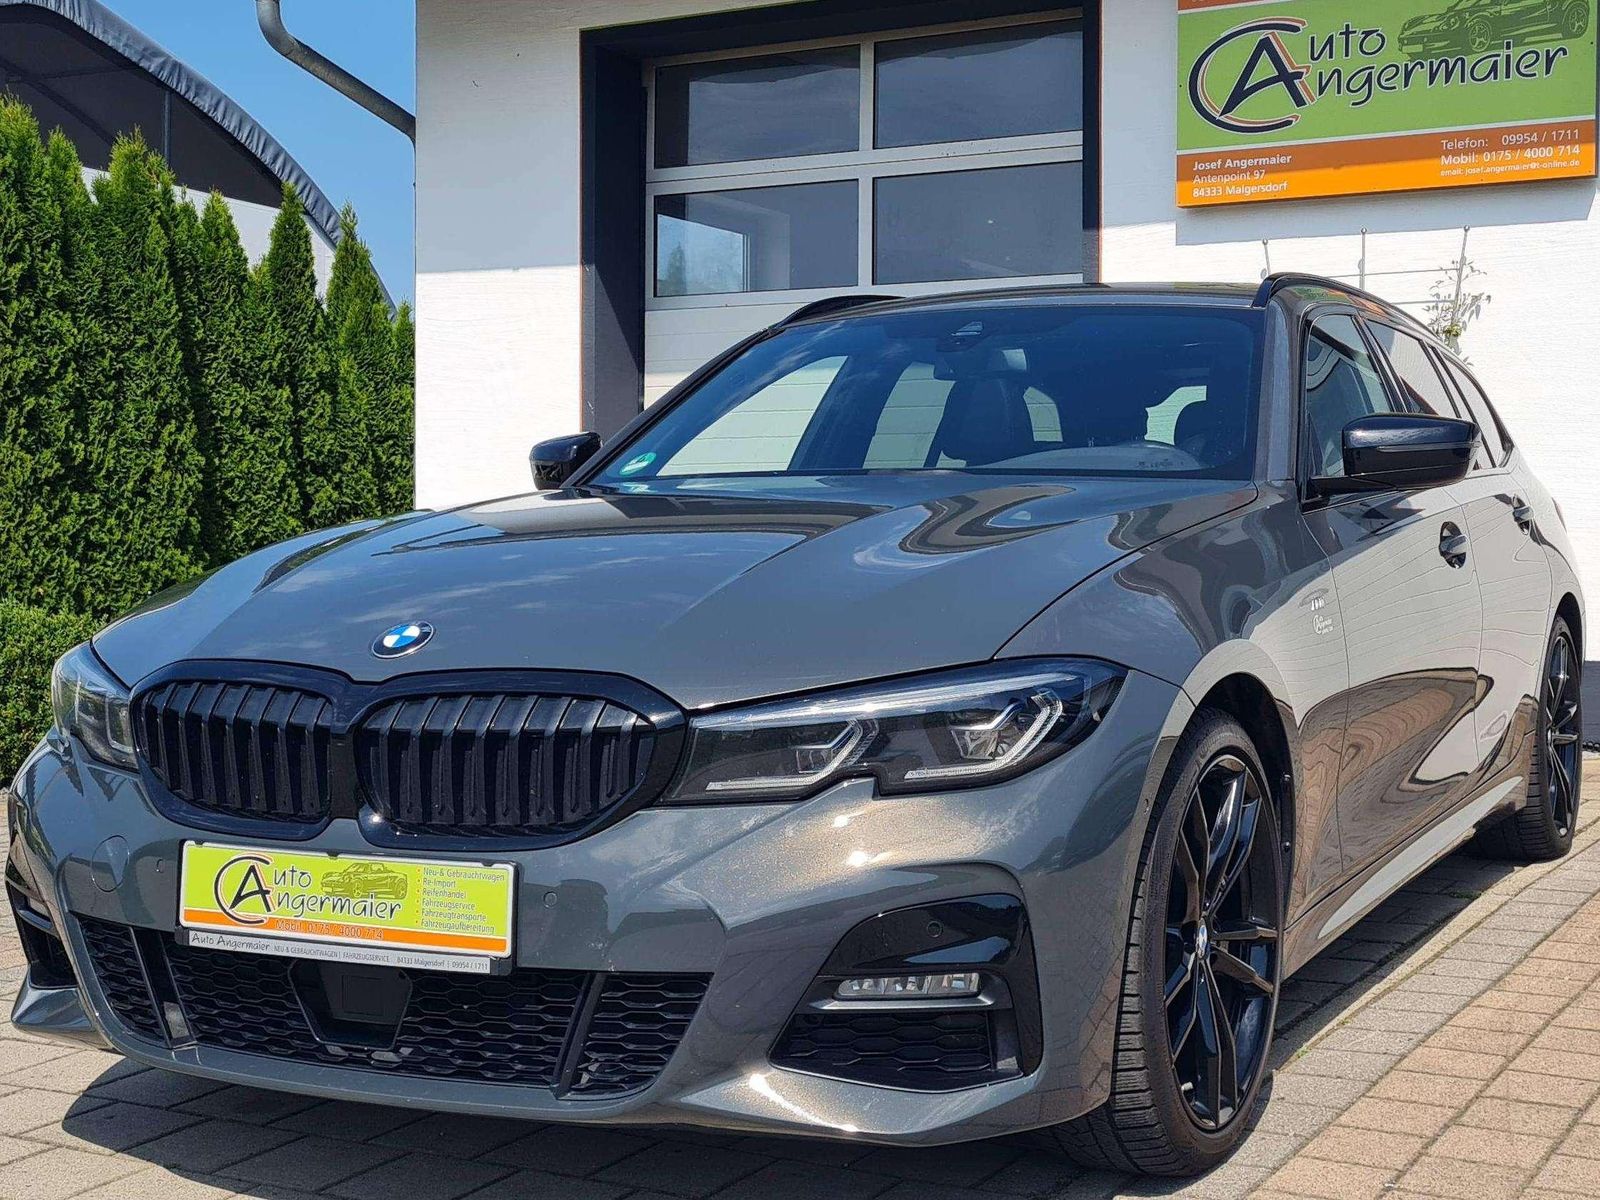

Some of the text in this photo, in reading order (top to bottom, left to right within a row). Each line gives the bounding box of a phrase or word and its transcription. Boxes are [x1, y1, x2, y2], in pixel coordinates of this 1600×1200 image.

[1441, 128, 1580, 150] Telefon: 09954 / 1711
[1192, 153, 1292, 171] Josef Angermaier
[1440, 152, 1479, 166] Mobil:
[1483, 149, 1512, 162] 0175
[1523, 146, 1554, 159] 4000
[1558, 144, 1581, 156] 714
[1192, 170, 1265, 185] Antenpoint 97
[1192, 187, 1222, 198] 84333
[339, 925, 362, 937] 4000
[191, 932, 215, 945] Auto
[216, 935, 270, 952] Angermaier
